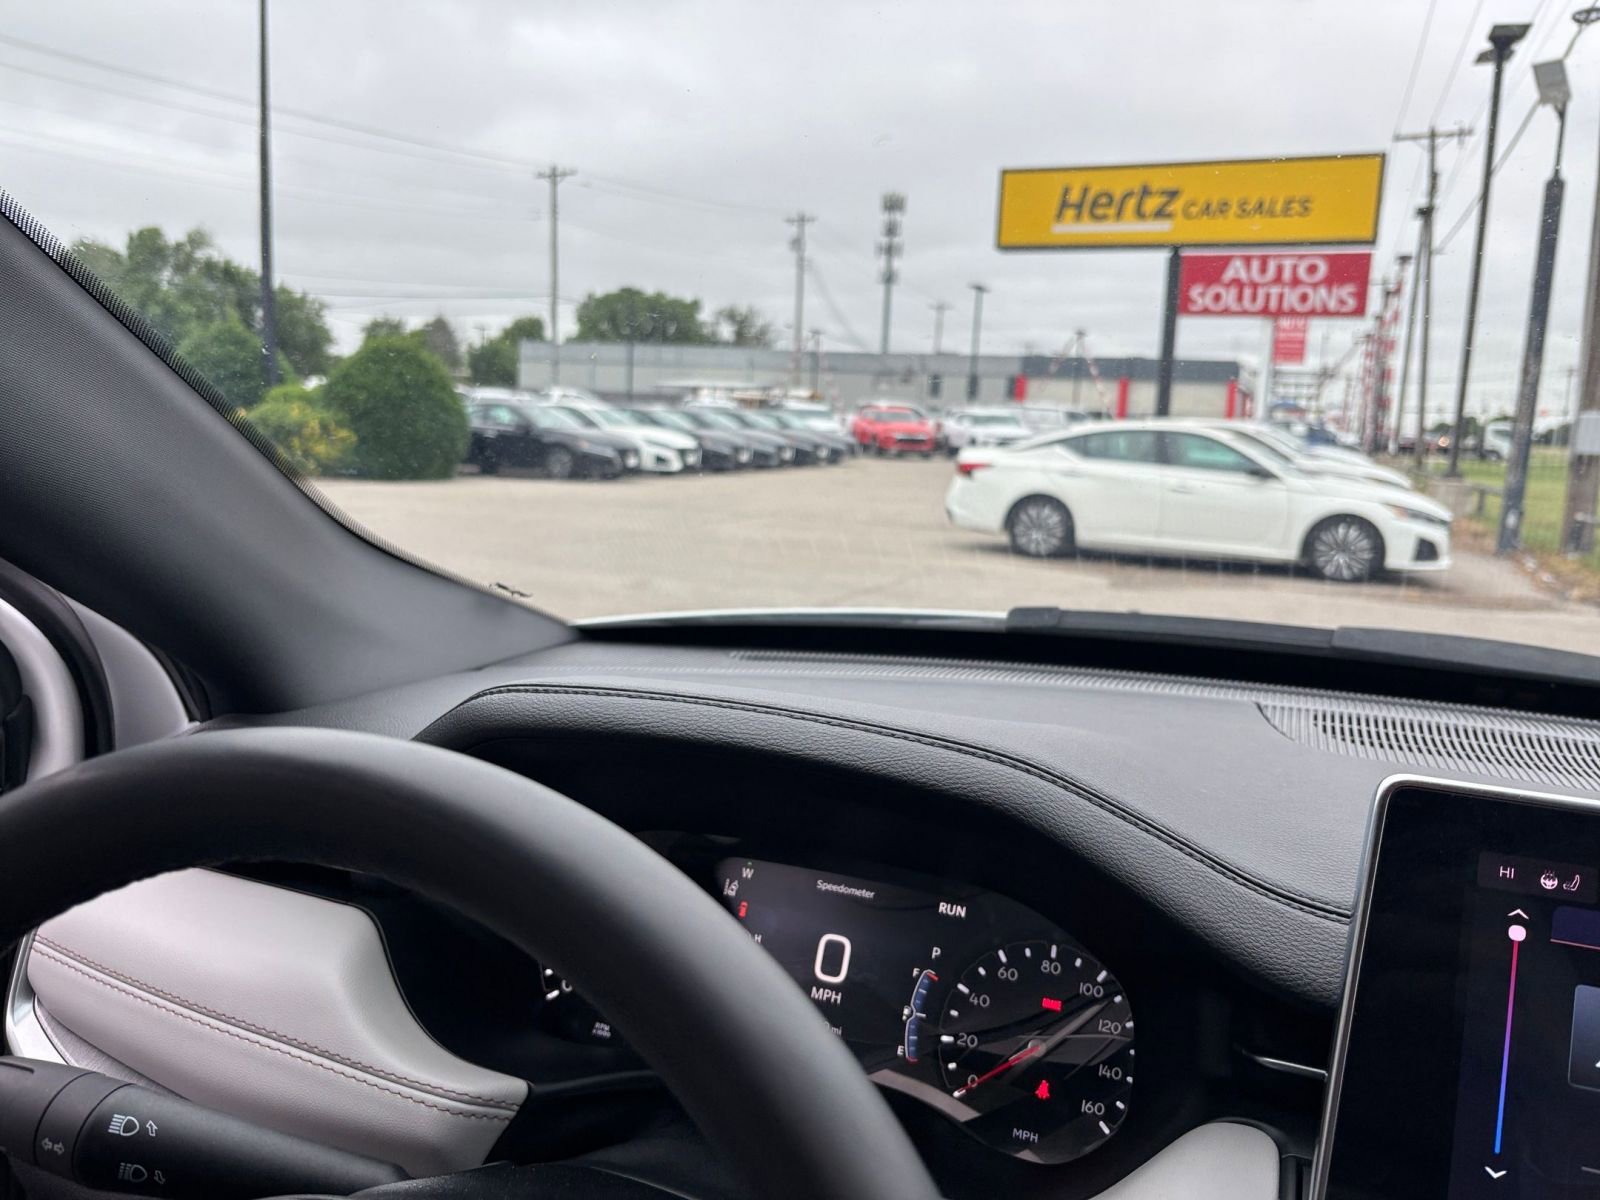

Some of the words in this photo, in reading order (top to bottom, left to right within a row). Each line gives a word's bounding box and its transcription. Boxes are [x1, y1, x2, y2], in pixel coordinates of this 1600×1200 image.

[1054, 182, 1183, 223] Hertz
[1182, 201, 1230, 220] CAR
[1234, 195, 1313, 219] SALES
[1221, 255, 1328, 284] AUTO
[1188, 284, 1357, 314] SOLUTIONS
[742, 867, 754, 880] W
[1499, 865, 1514, 880] HI
[816, 879, 875, 899] Speedometer
[938, 902, 966, 918] RUN
[814, 933, 851, 984] 0
[931, 946, 941, 960] P
[912, 967, 921, 978] F
[997, 967, 1018, 981] 60
[1041, 960, 1061, 975] 80
[811, 986, 842, 1004] MPH
[1079, 982, 1104, 998] 100
[969, 993, 990, 1008] 40
[1098, 1019, 1122, 1034] 120
[956, 1032, 978, 1048] 20
[897, 1045, 905, 1056] E
[1098, 1064, 1122, 1080] 140
[967, 1074, 979, 1088] 0
[1081, 1099, 1105, 1116] 160
[1012, 1127, 1039, 1143] MPH
